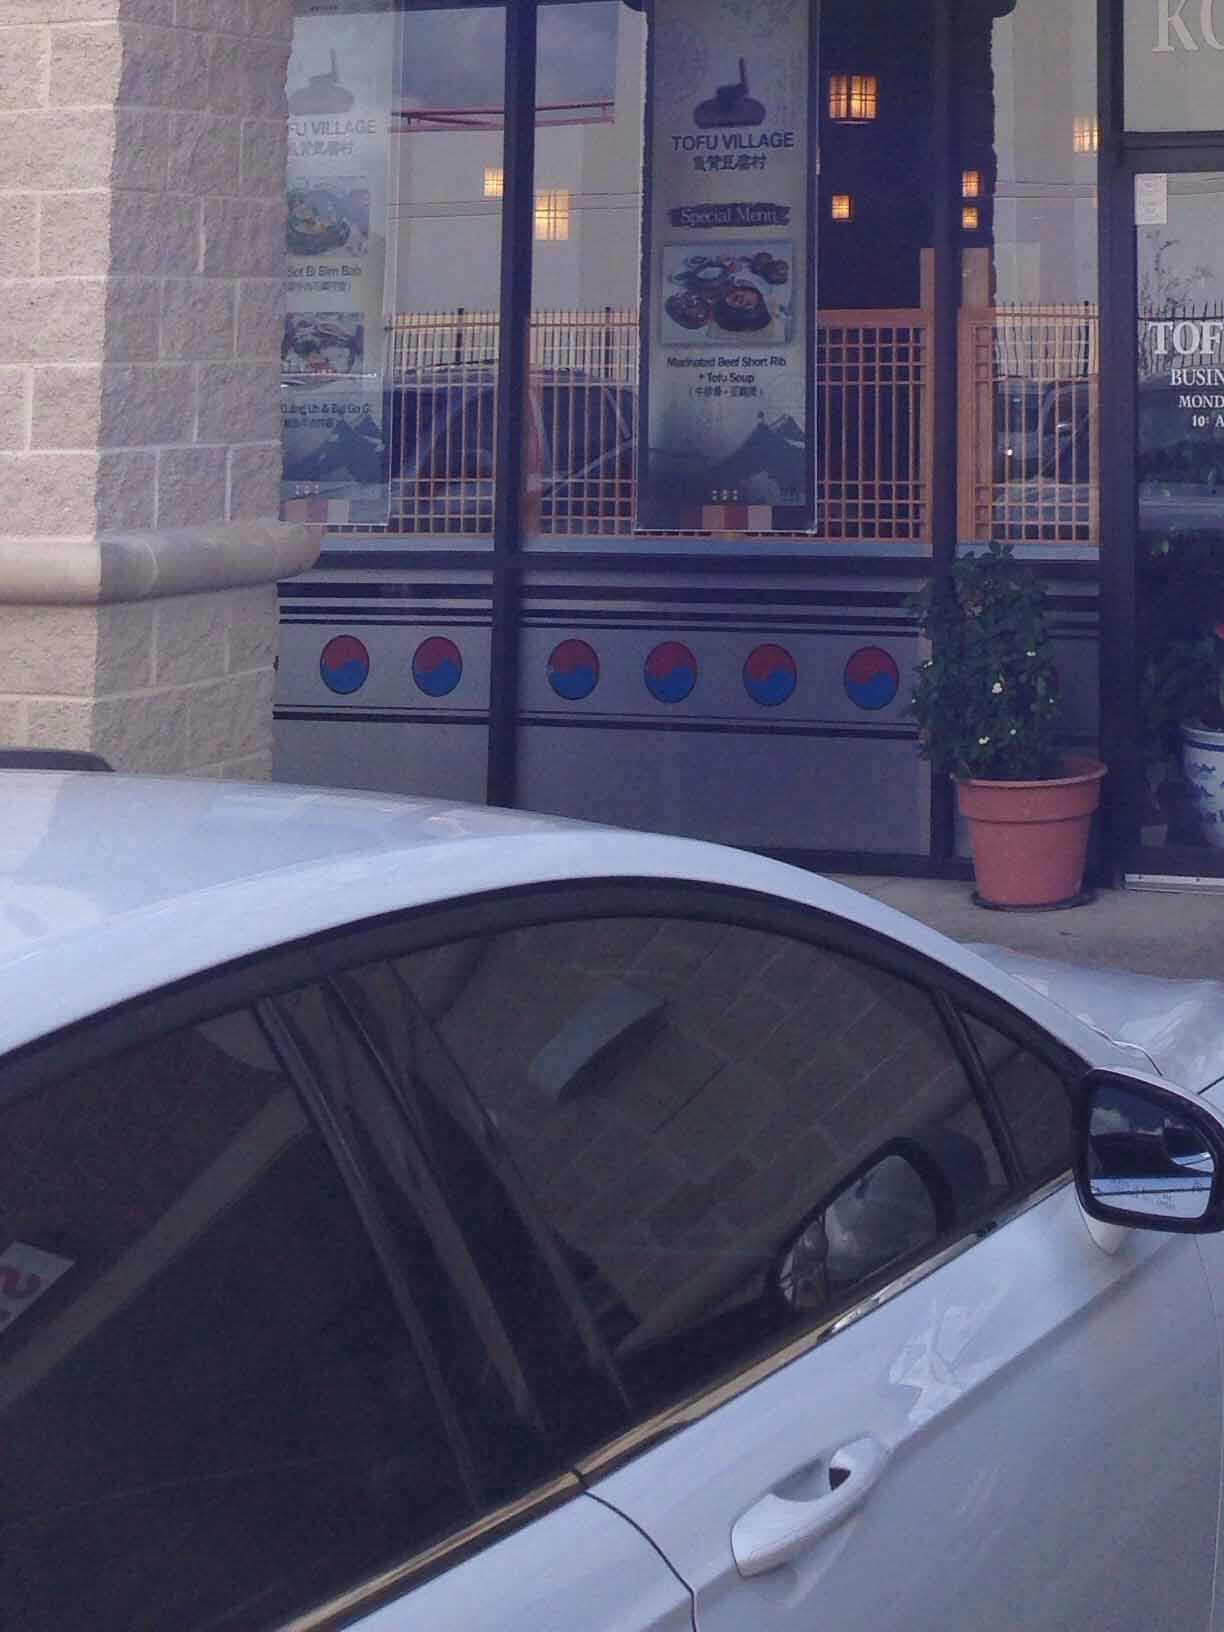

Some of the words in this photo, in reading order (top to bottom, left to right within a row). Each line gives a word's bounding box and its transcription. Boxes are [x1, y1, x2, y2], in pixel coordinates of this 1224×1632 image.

[671, 134, 718, 152] TOFU
[721, 131, 795, 151] VILLAGE
[680, 207, 731, 227] Special
[718, 355, 740, 368] Beef
[741, 355, 769, 368] Short
[770, 355, 787, 367] Rib
[728, 371, 755, 385] Soup
